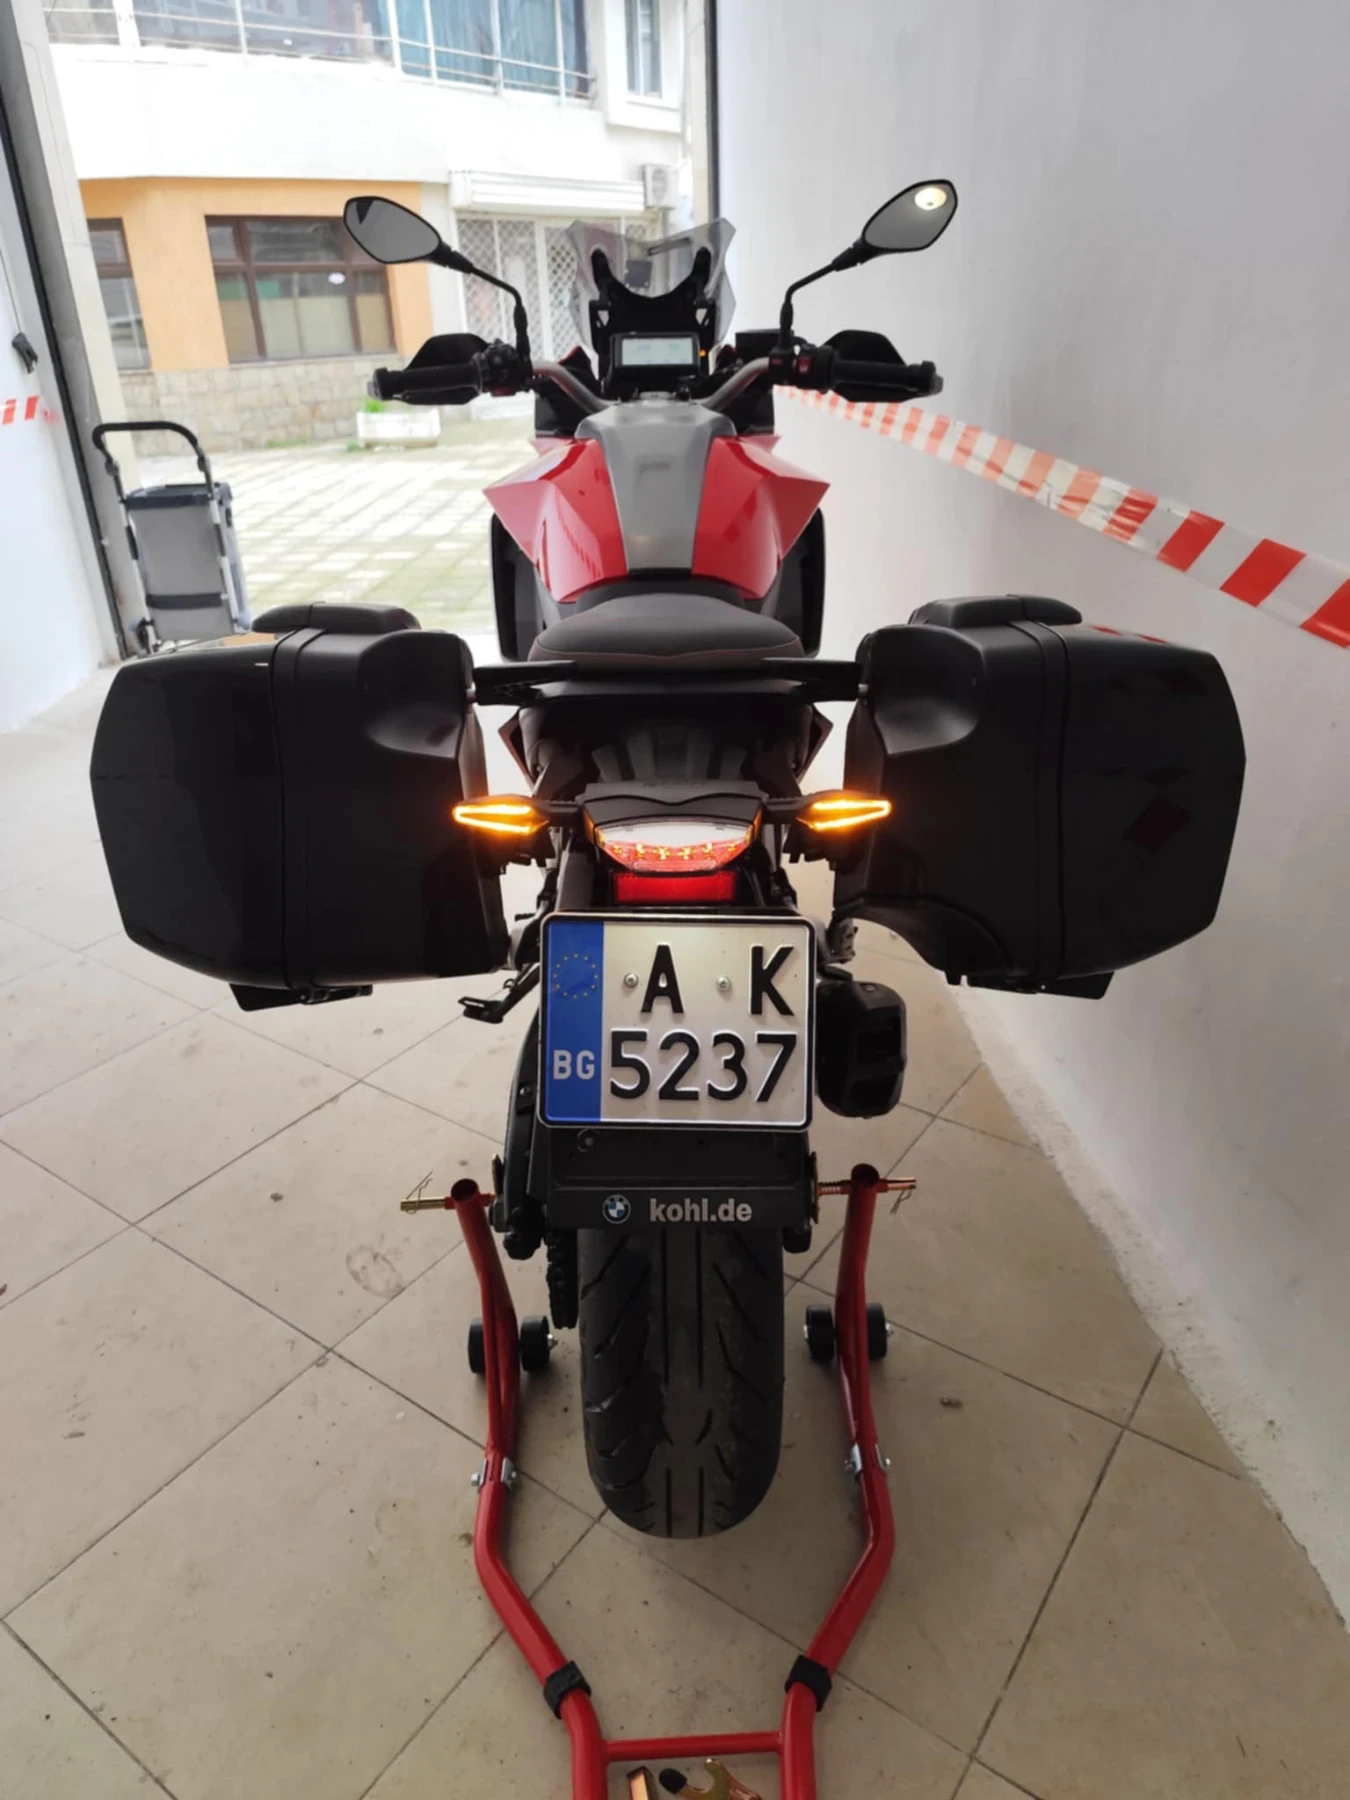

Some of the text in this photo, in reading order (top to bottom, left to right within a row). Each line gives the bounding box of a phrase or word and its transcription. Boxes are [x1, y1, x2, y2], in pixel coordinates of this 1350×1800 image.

[640, 943, 795, 1016] A K
[552, 1049, 596, 1080] BG
[610, 1028, 798, 1102] 5237
[650, 1198, 753, 1222] kohl.de
